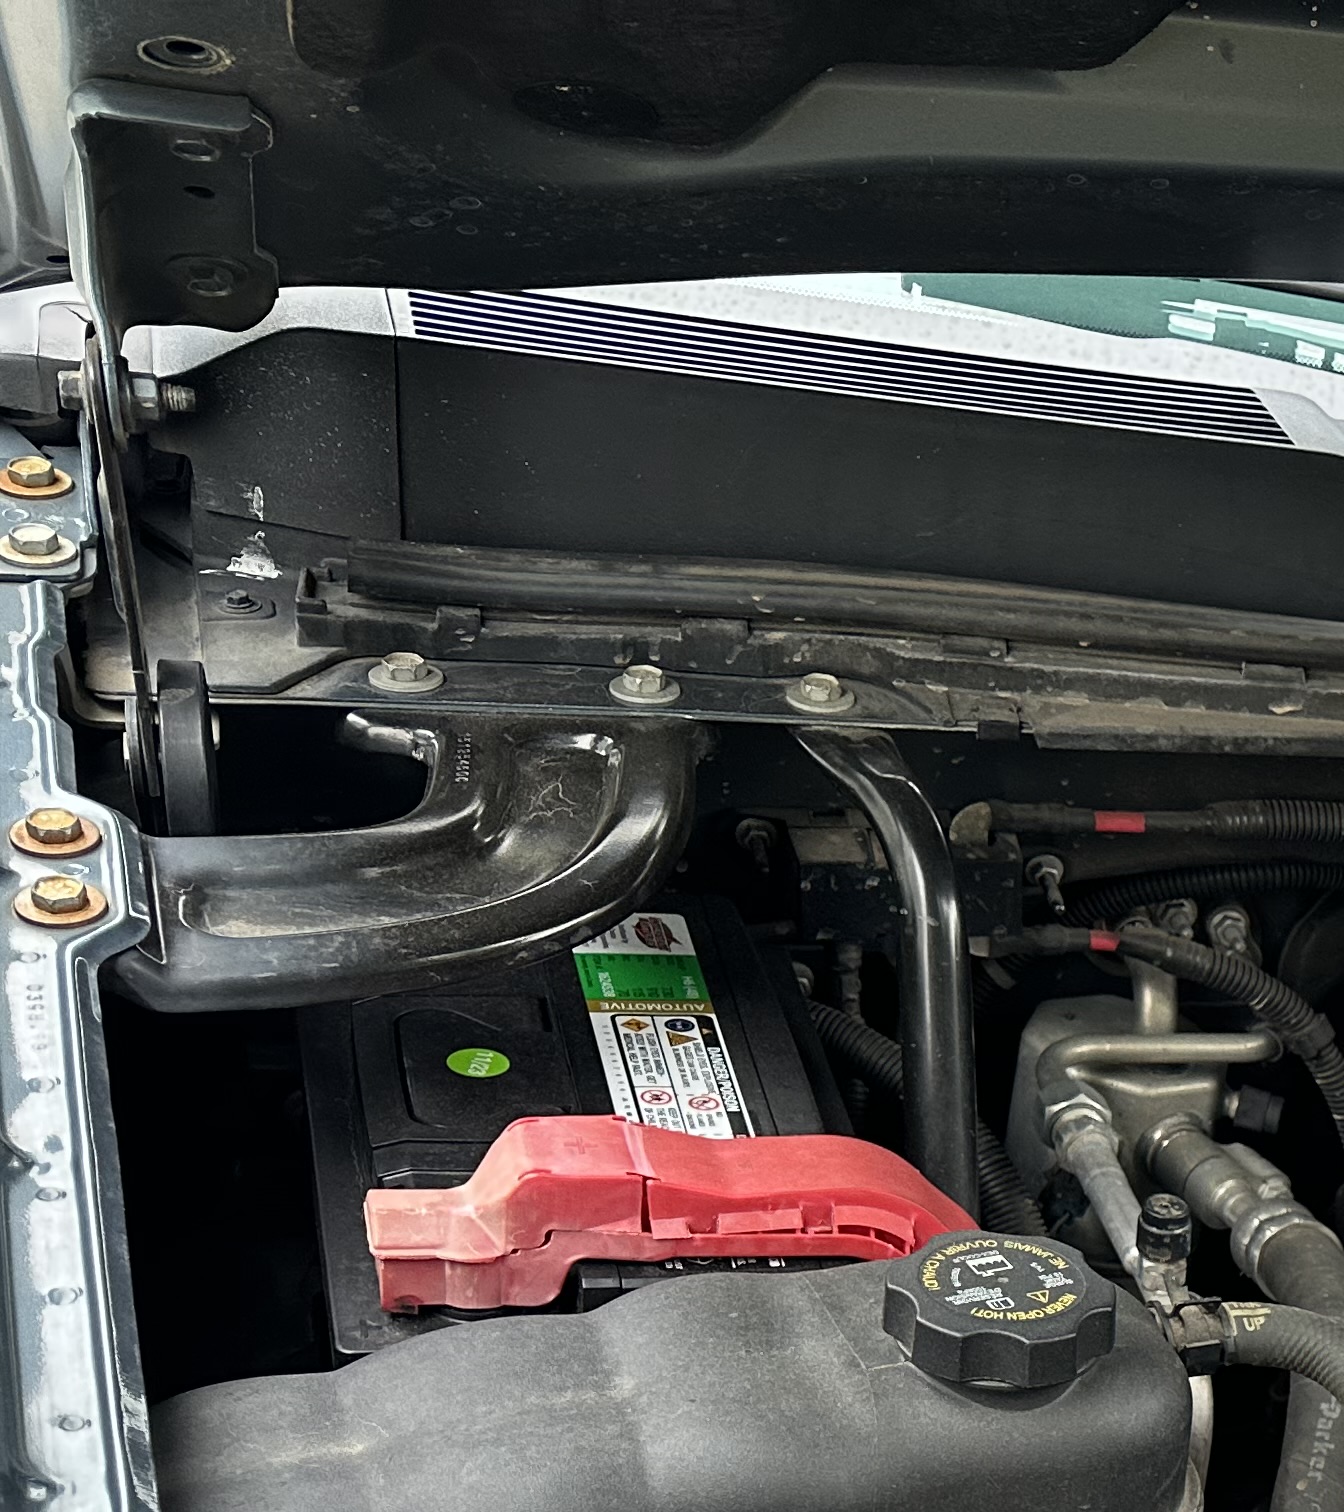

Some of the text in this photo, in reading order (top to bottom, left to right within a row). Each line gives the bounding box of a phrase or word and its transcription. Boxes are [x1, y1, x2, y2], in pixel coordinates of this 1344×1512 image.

[600, 1002, 705, 1011] AUTOMOTIVE
[467, 1052, 494, 1076] 11/23
[706, 1046, 740, 1112] DANGER/POISON
[947, 1239, 998, 1256] OUVRIR
[1004, 1240, 1049, 1261] JAMAIS
[1048, 1255, 1070, 1270] NE
[970, 1293, 1077, 1321] NEVER OPEN HOT!
[1243, 1315, 1266, 1332] UP
[1309, 1396, 1342, 1483] Parker
